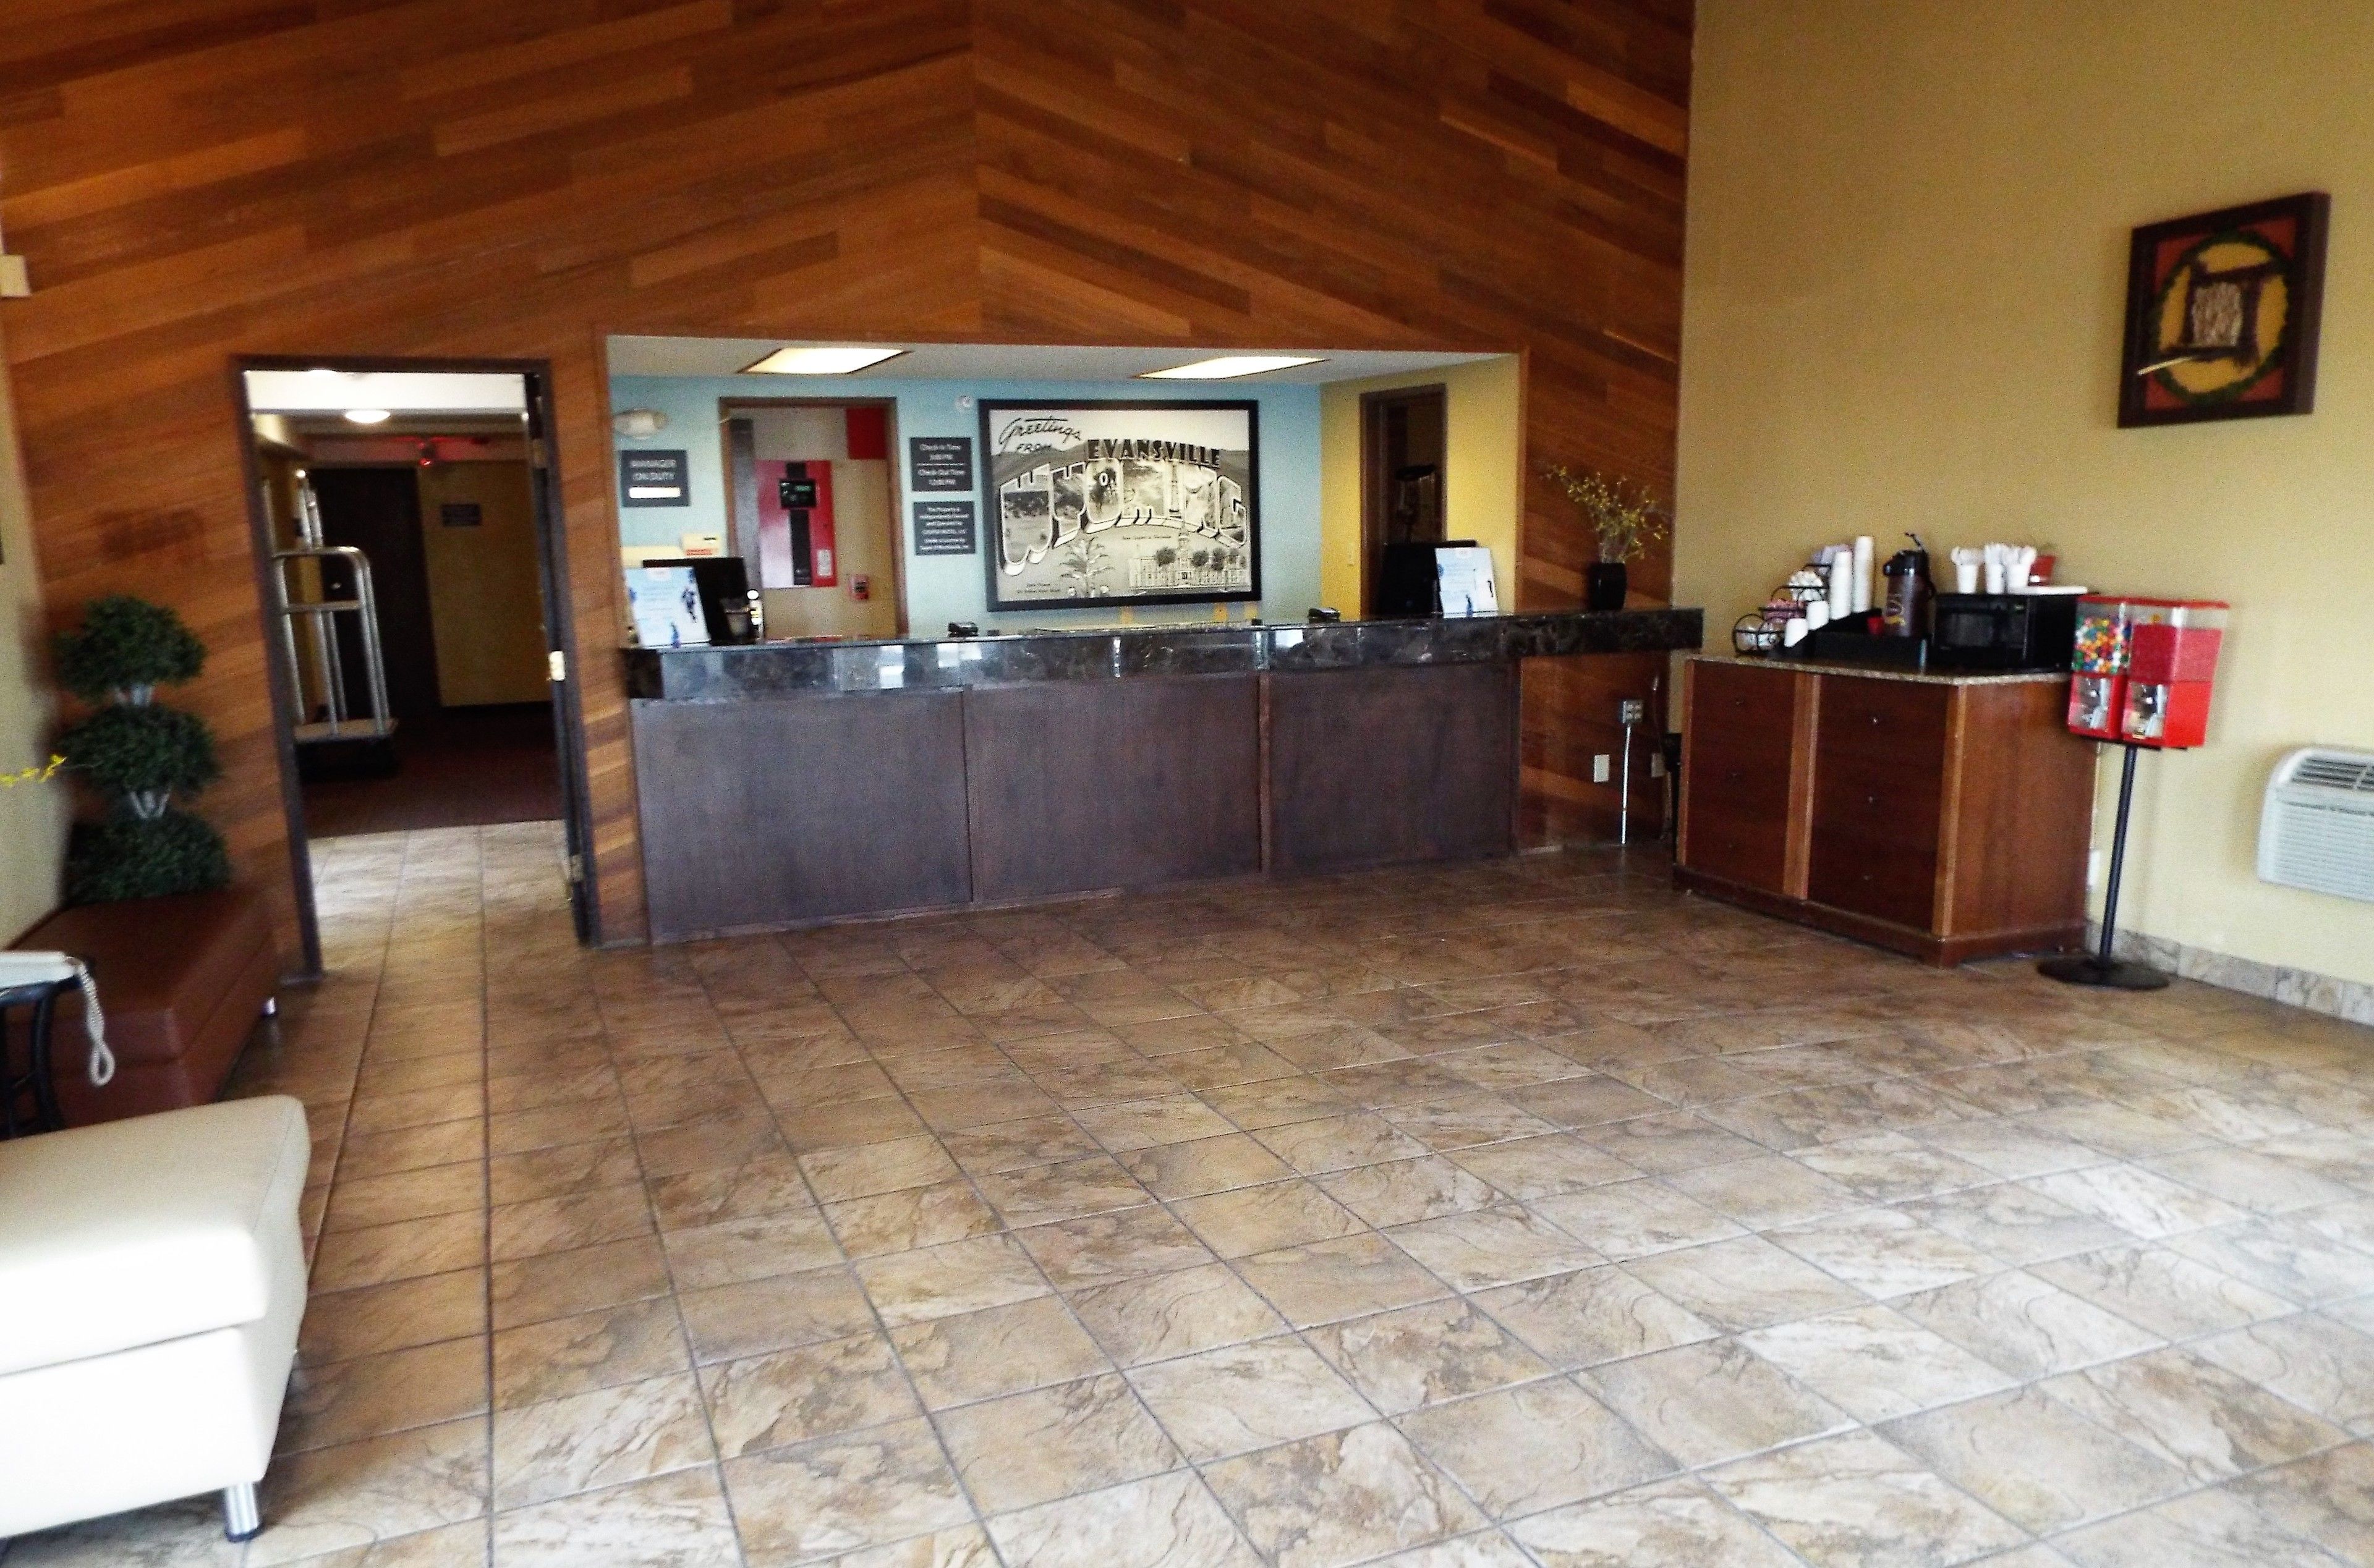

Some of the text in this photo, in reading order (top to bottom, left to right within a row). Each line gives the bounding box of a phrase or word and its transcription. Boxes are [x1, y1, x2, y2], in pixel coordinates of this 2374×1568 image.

[998, 416, 1081, 454] Greetings
[1087, 438, 1220, 468] EVANSVILLE
[999, 459, 1247, 577] WYOMING
